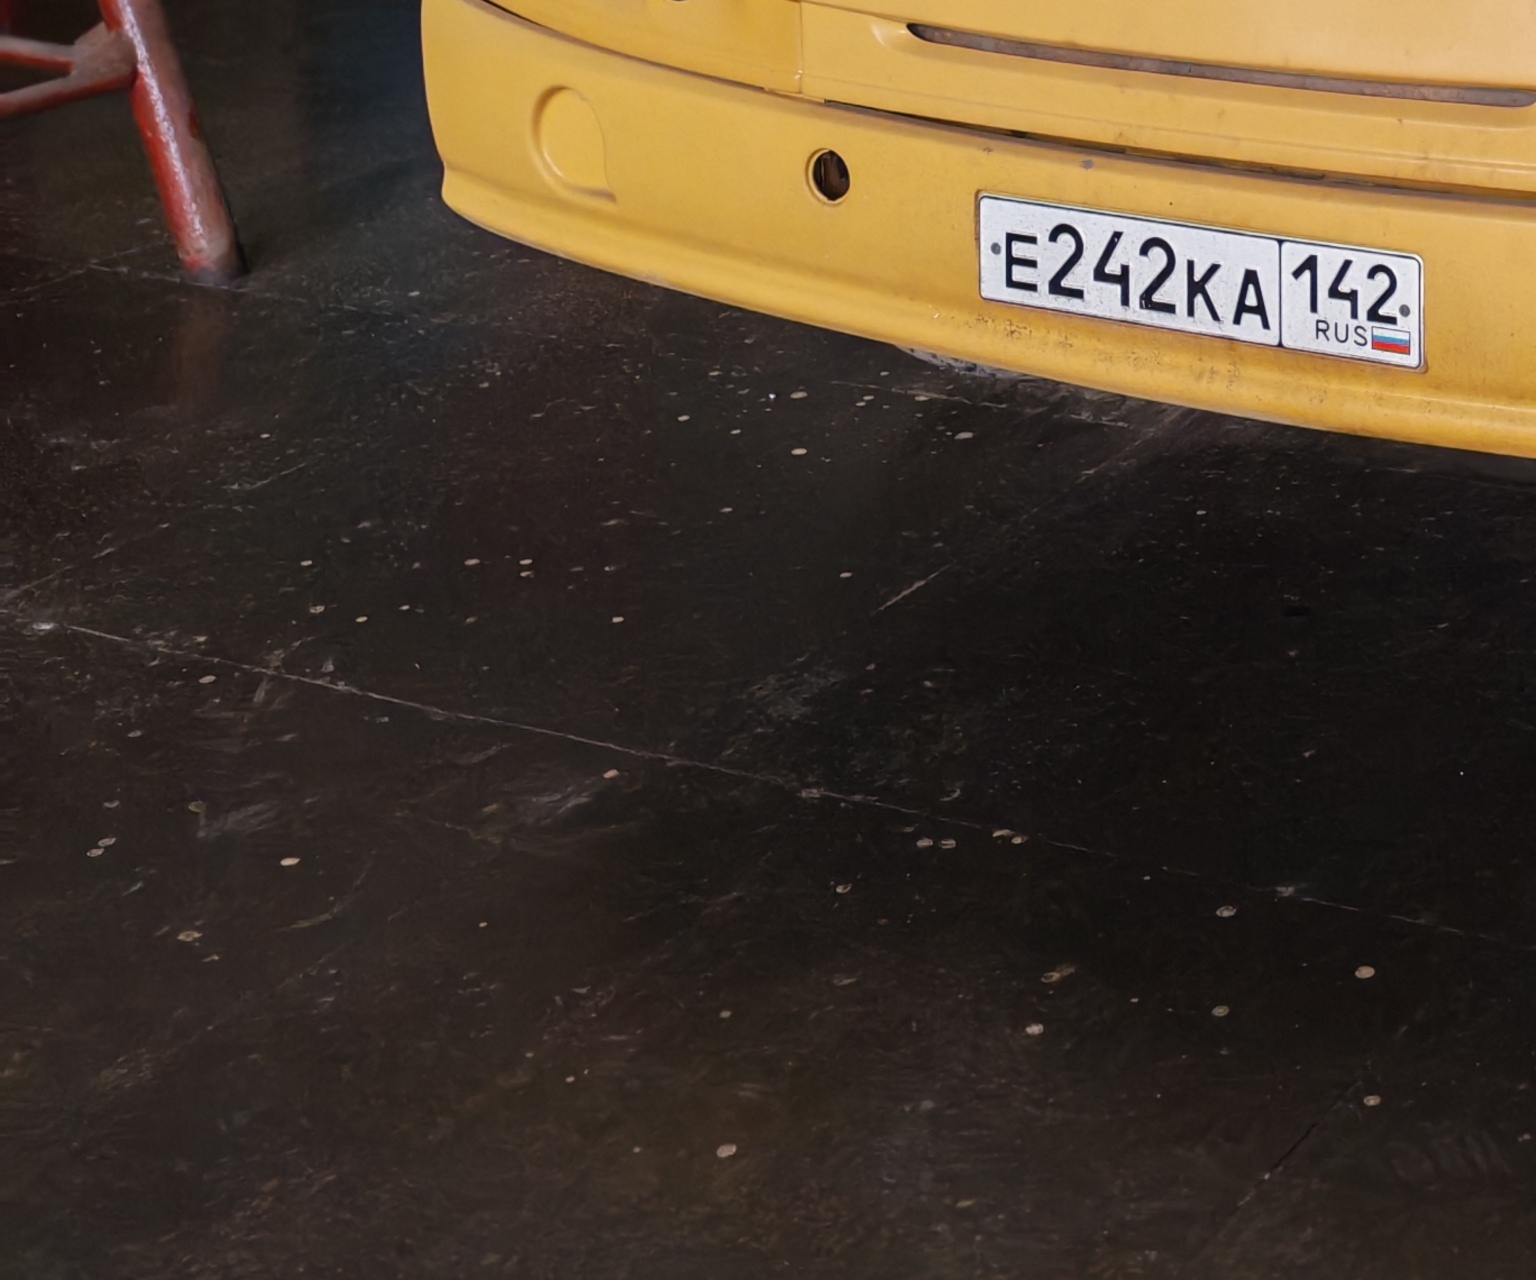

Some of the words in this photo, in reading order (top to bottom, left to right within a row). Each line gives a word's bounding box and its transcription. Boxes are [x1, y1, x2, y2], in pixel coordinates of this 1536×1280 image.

[1004, 223, 1271, 331] Е242КА
[1291, 254, 1399, 326] 142
[1314, 318, 1368, 348] RUS
